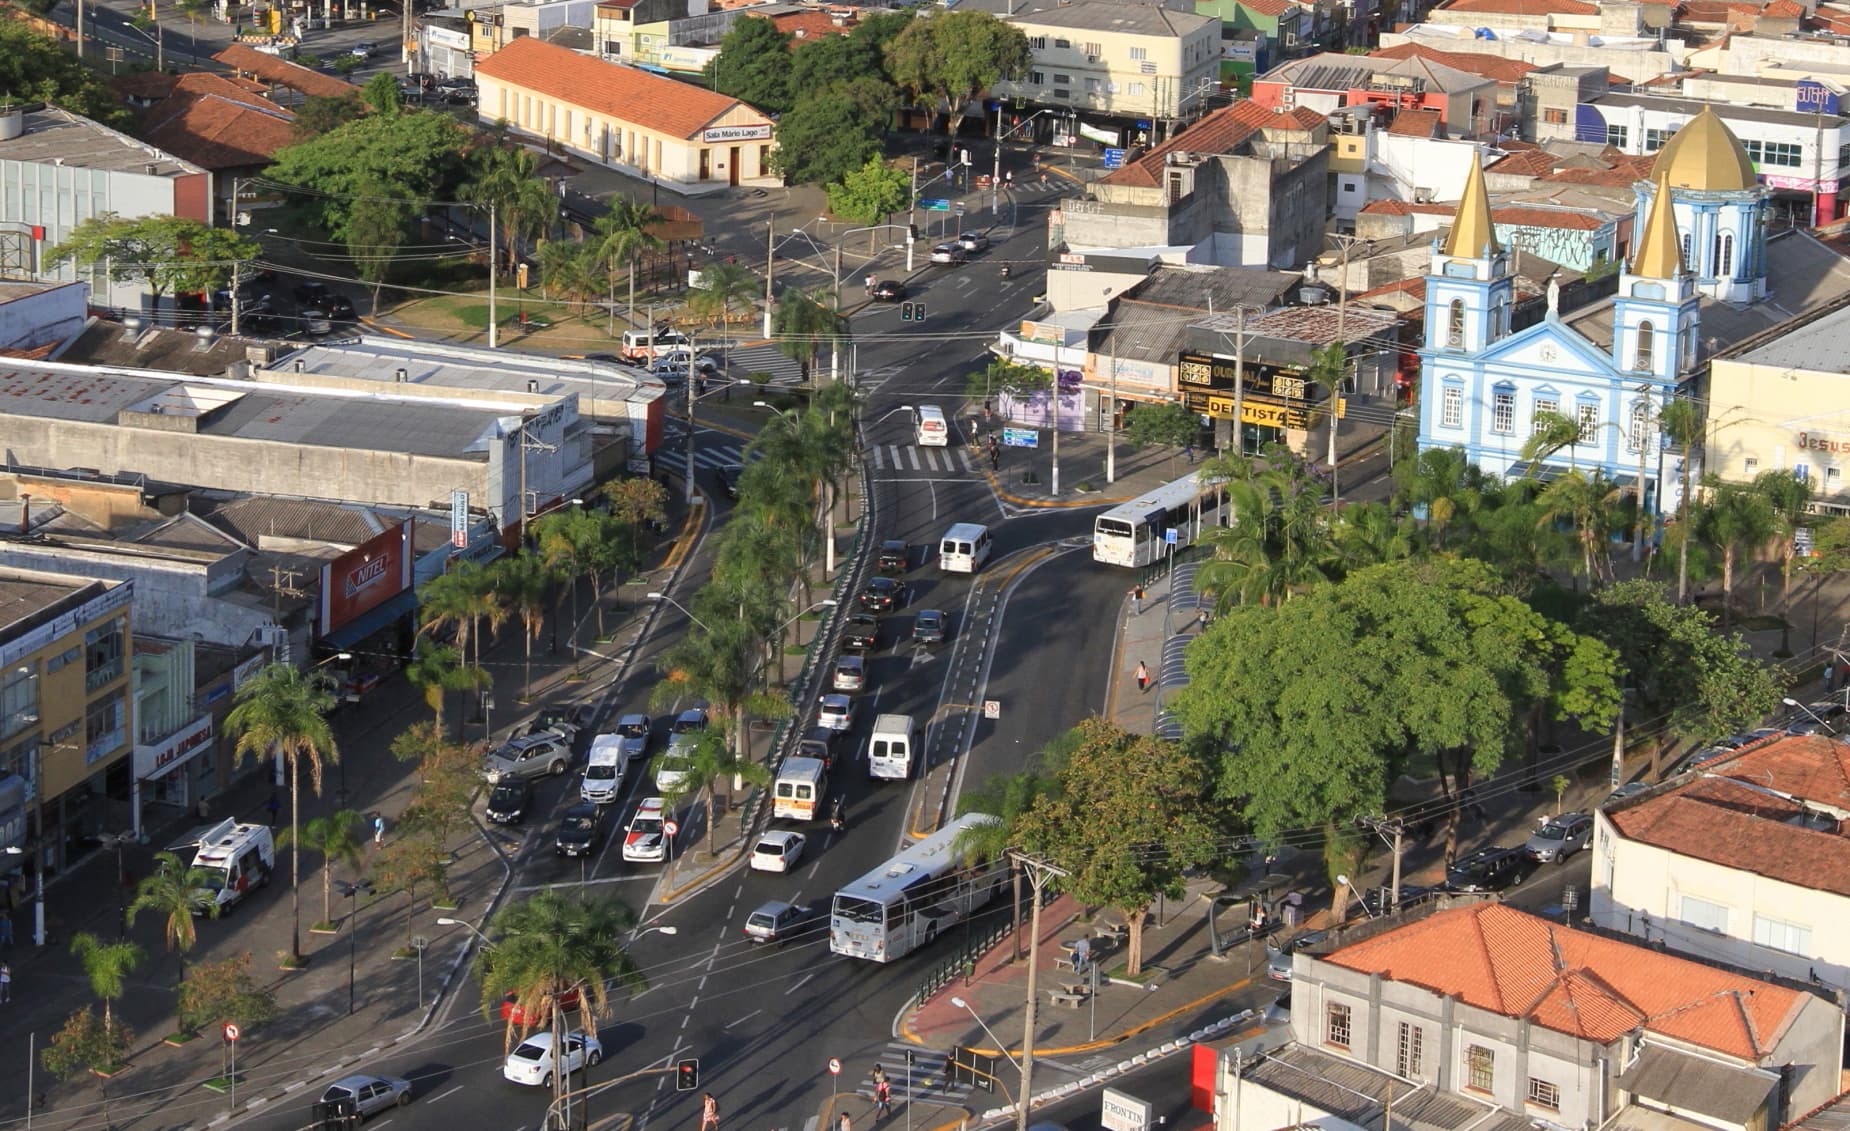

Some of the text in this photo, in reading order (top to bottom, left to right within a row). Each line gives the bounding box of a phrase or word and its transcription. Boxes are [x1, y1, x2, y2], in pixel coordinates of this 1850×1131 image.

[706, 131, 720, 139] Sala
[721, 130, 741, 138] Mário
[742, 129, 758, 138] Lago
[1798, 431, 1850, 453] Jesus
[358, 558, 385, 585] NITEL
[1104, 1100, 1143, 1124] FRONTIN
